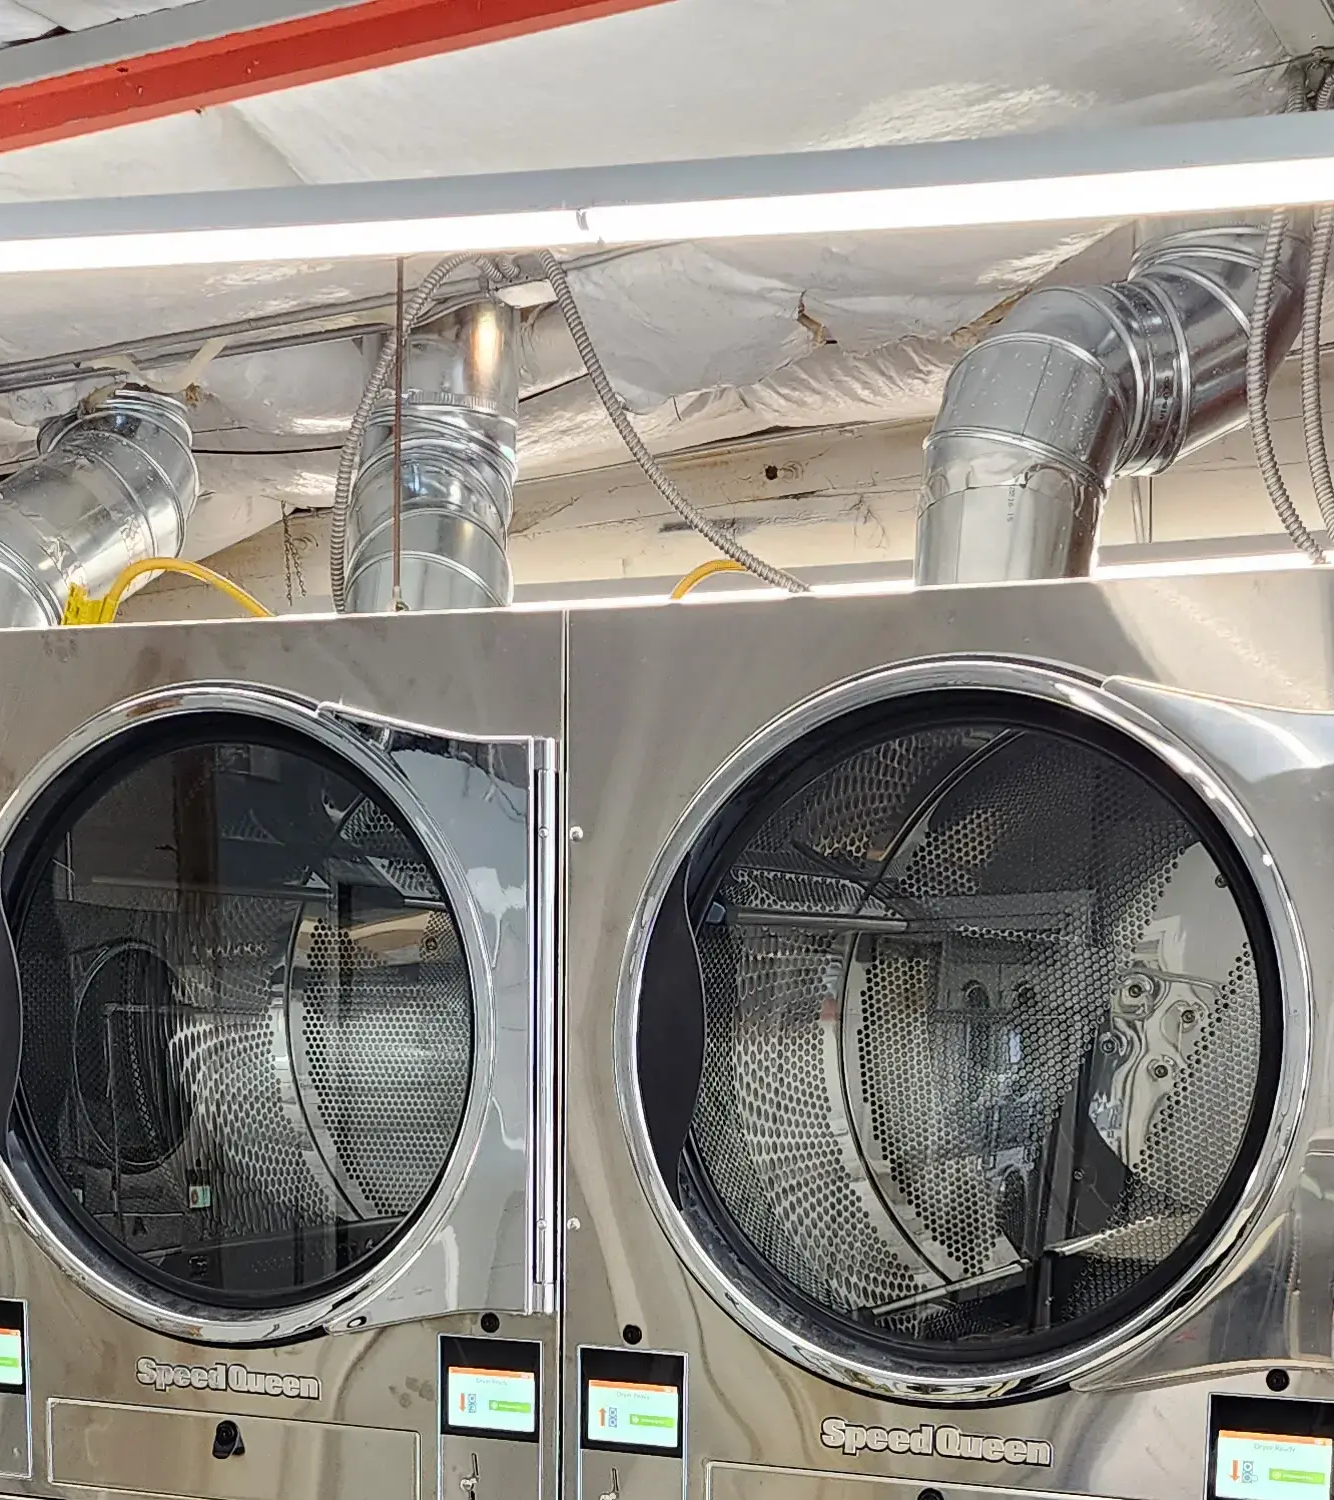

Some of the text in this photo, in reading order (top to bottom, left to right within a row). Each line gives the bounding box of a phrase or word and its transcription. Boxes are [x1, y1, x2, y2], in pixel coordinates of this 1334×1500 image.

[136, 1356, 322, 1400] Speed Queen
[820, 1416, 1053, 1467] Speed Queen
